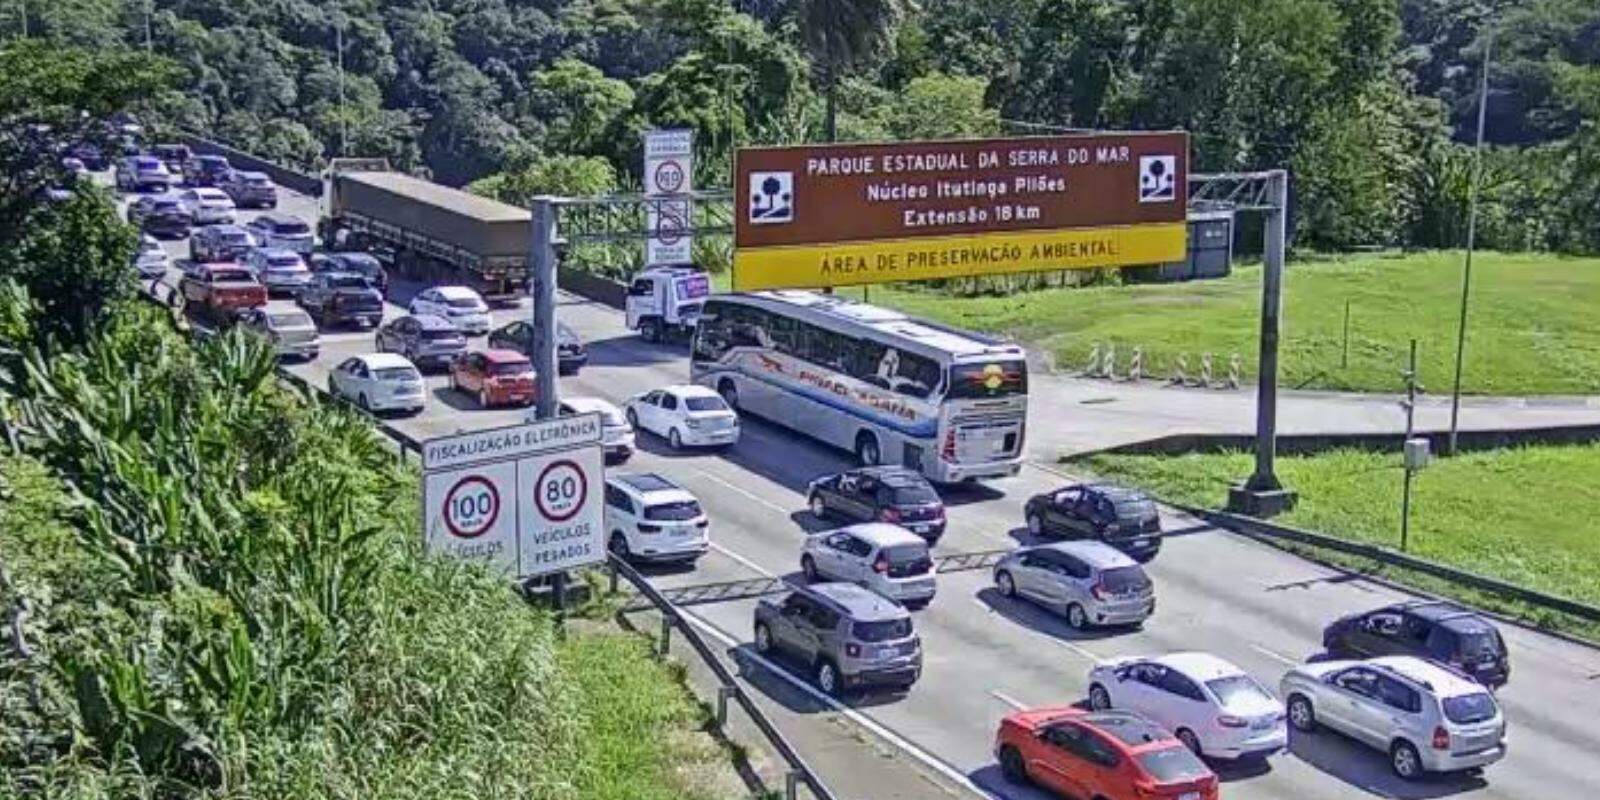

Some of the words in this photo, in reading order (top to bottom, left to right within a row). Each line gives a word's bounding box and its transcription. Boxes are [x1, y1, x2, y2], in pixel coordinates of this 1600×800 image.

[807, 156, 874, 175] PARQUE
[883, 153, 969, 172] ESTADUAL
[978, 151, 999, 168] DA
[1009, 149, 1059, 166] SERRA
[1068, 148, 1088, 164] DO
[1096, 146, 1130, 163] MAR
[867, 180, 928, 201] Núcleo
[937, 178, 1007, 199] Itutinga
[1015, 175, 1065, 193] Pilões
[904, 206, 988, 226] Extensão
[1016, 204, 1040, 220] km
[820, 252, 868, 275] ÁREA
[877, 253, 899, 271] DE
[907, 242, 1020, 268] PRESERVAÇÃO
[1030, 239, 1116, 260] AMBIENTAL
[429, 434, 521, 461] FISCALIZAÇÃO
[525, 421, 597, 445] ELETRÔNICA
[546, 476, 577, 503] 80
[451, 492, 492, 521] 100
[534, 523, 591, 545] VEÍCULOS
[535, 543, 591, 565] PESADOS
